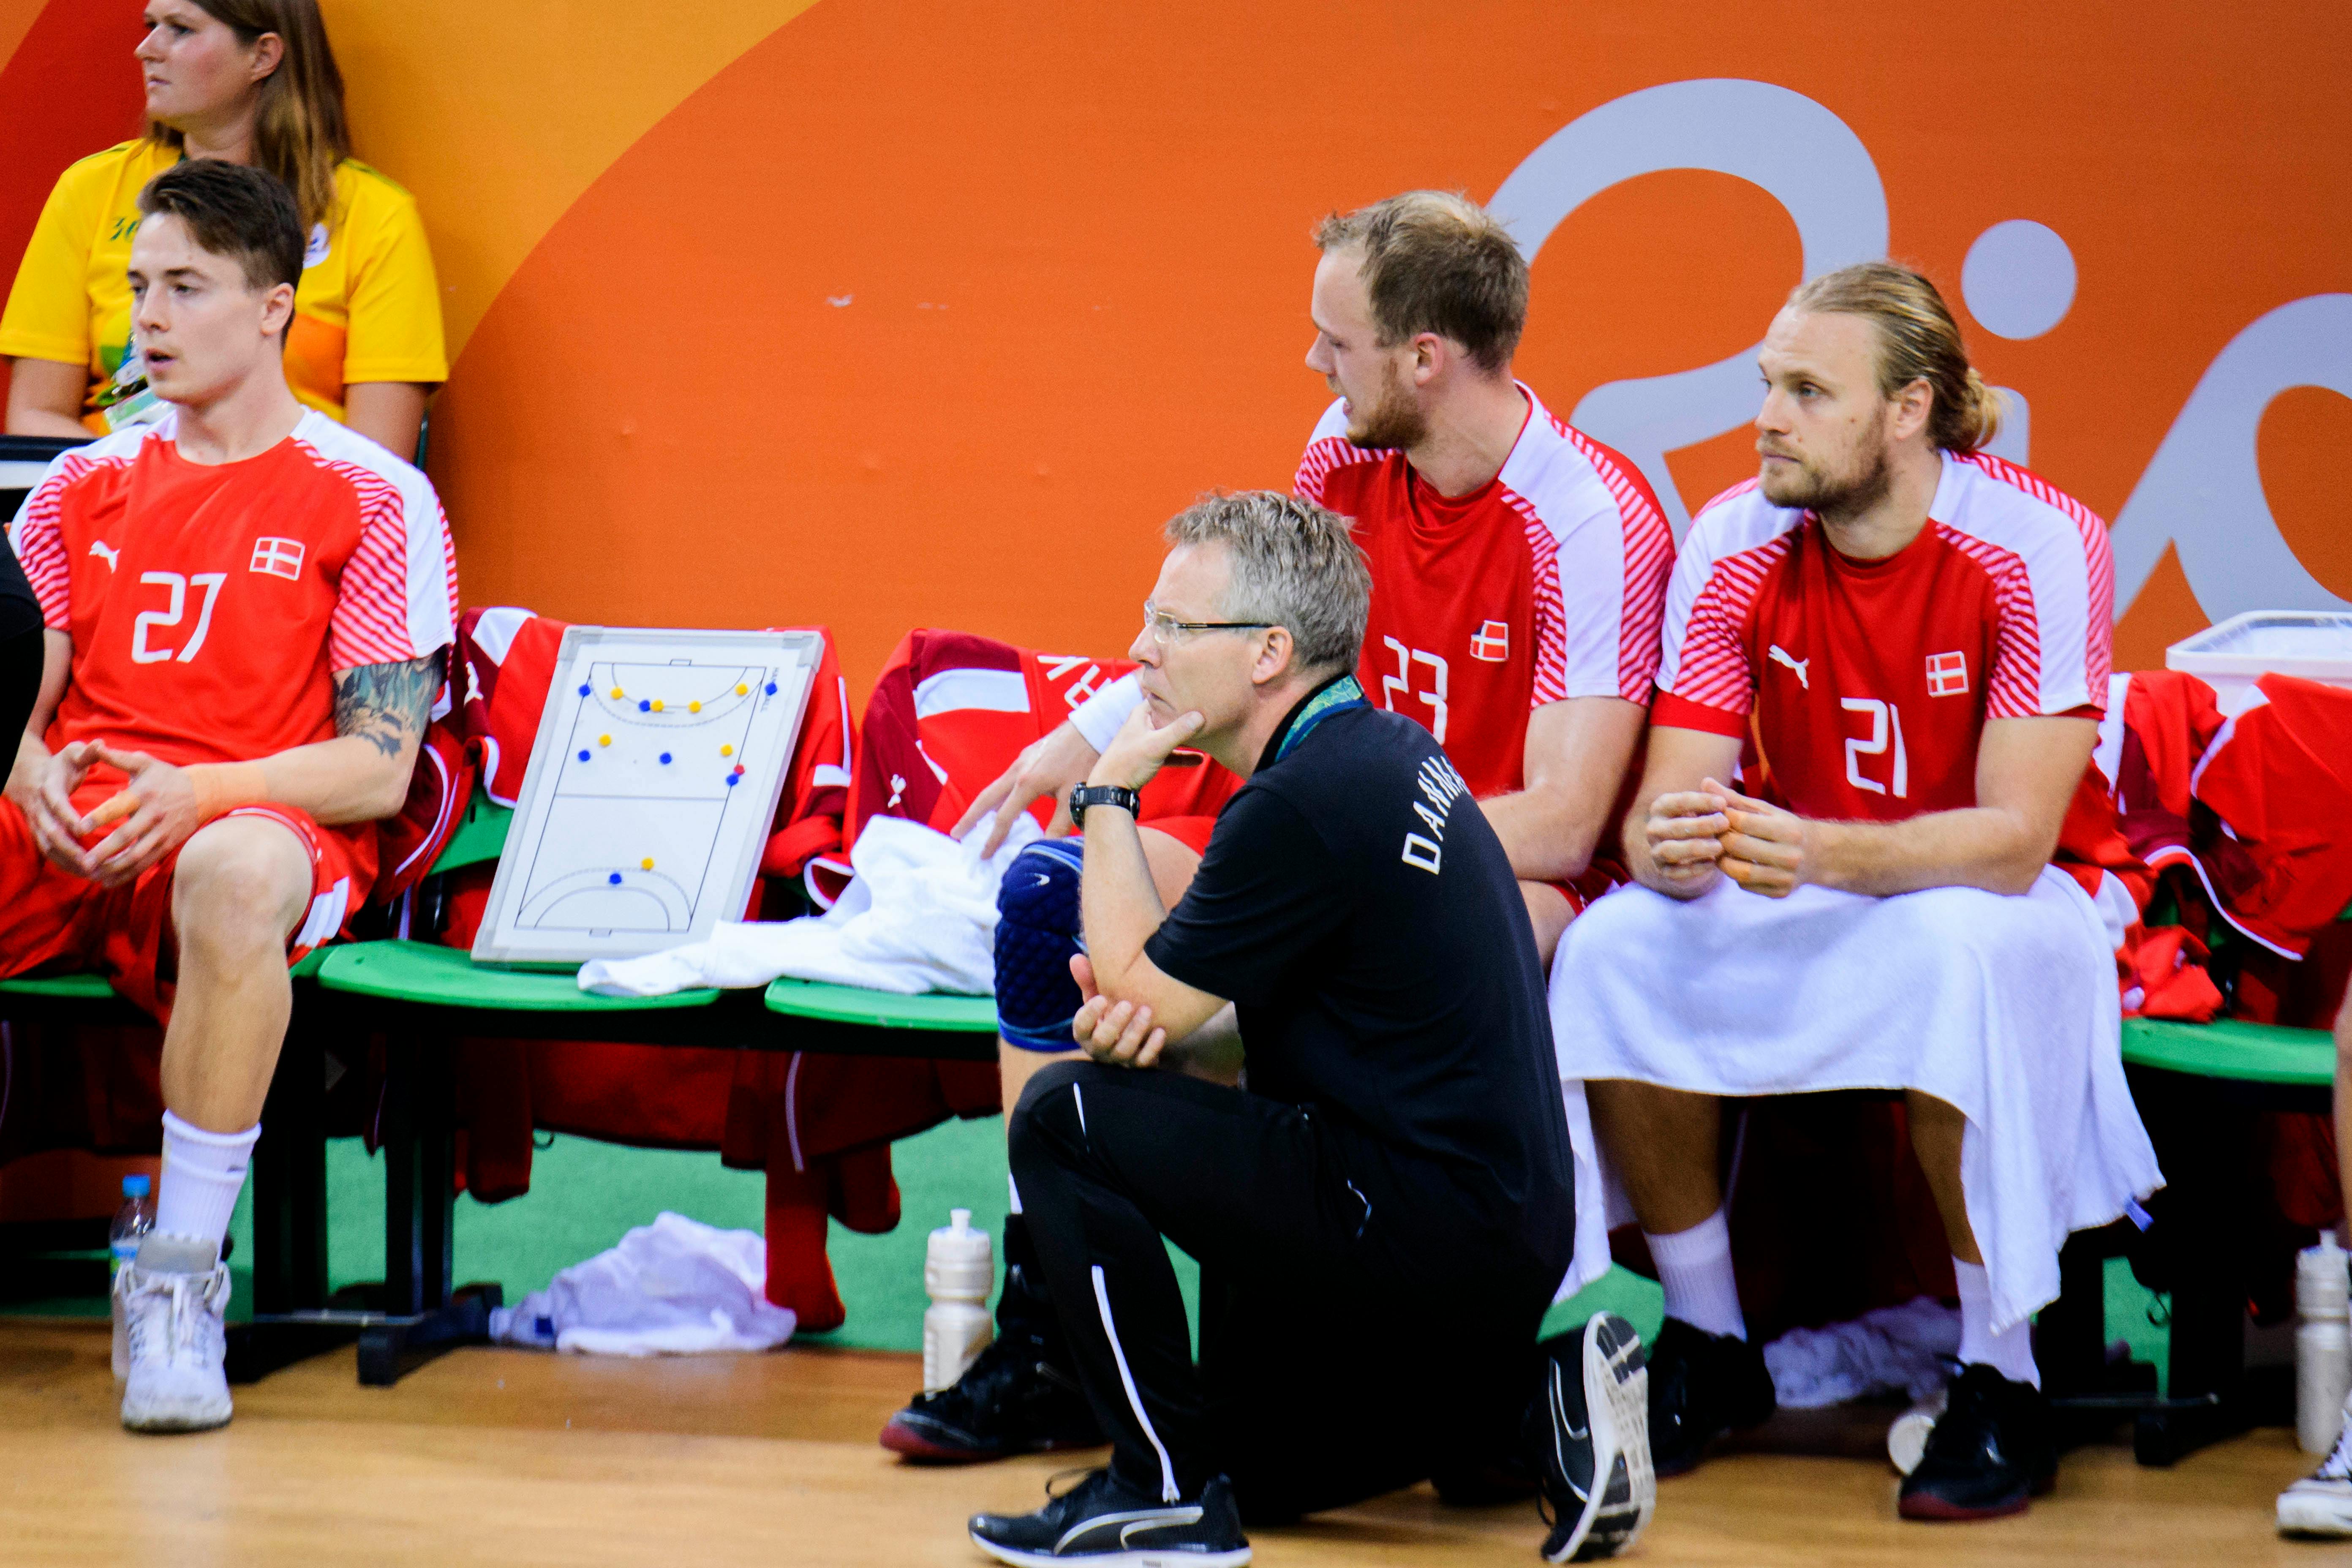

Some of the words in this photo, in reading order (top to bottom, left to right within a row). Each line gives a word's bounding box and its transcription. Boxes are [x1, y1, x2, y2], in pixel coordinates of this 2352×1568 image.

[131, 571, 227, 664] 27
[1382, 634, 1449, 746] 23
[1840, 697, 1908, 798] 21
